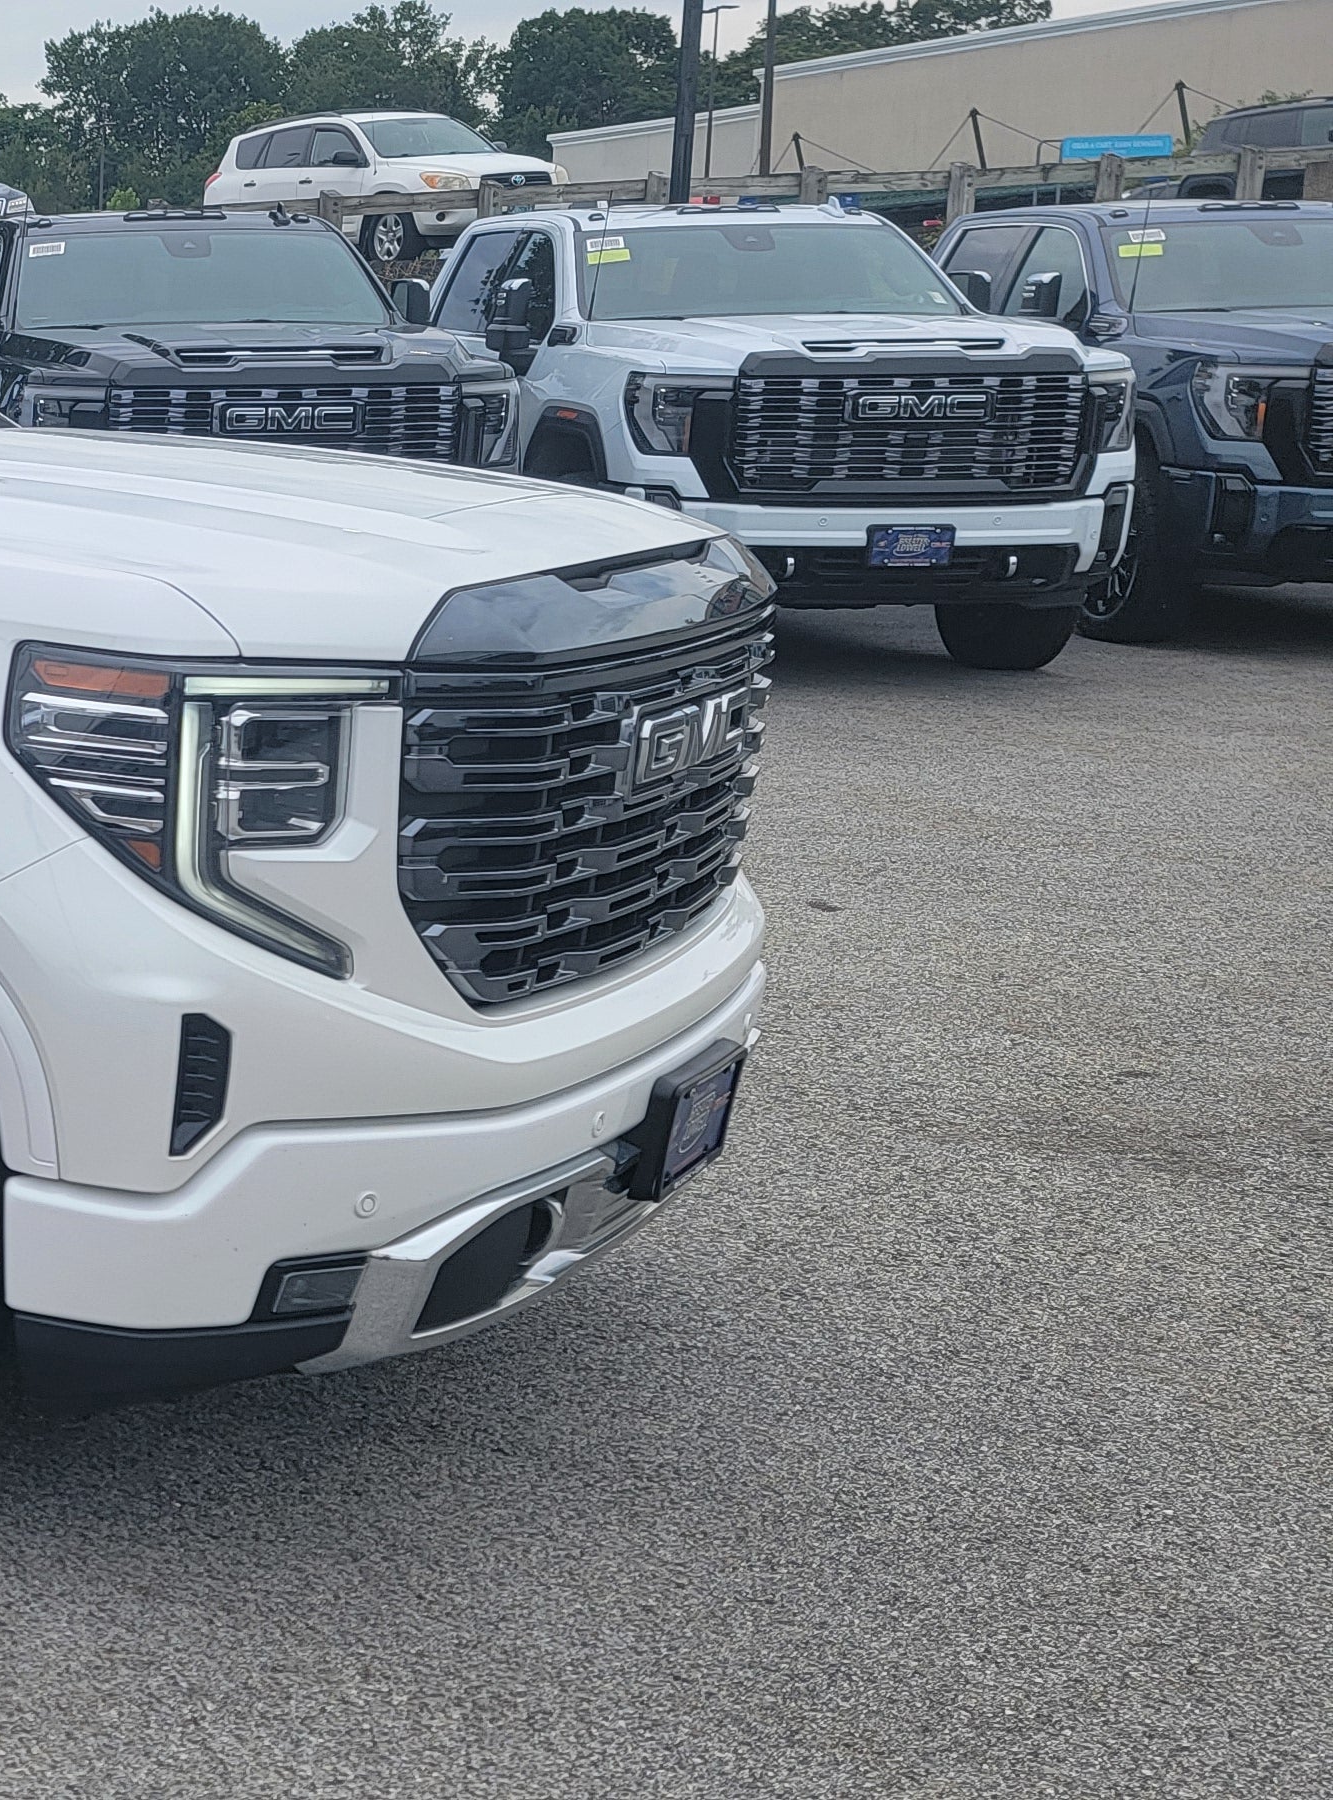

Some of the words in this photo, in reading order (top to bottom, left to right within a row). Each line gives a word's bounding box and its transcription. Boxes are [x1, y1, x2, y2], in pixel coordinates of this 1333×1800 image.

[226, 406, 353, 430] GMC
[858, 395, 986, 417] GMC
[635, 686, 749, 785] GMC
